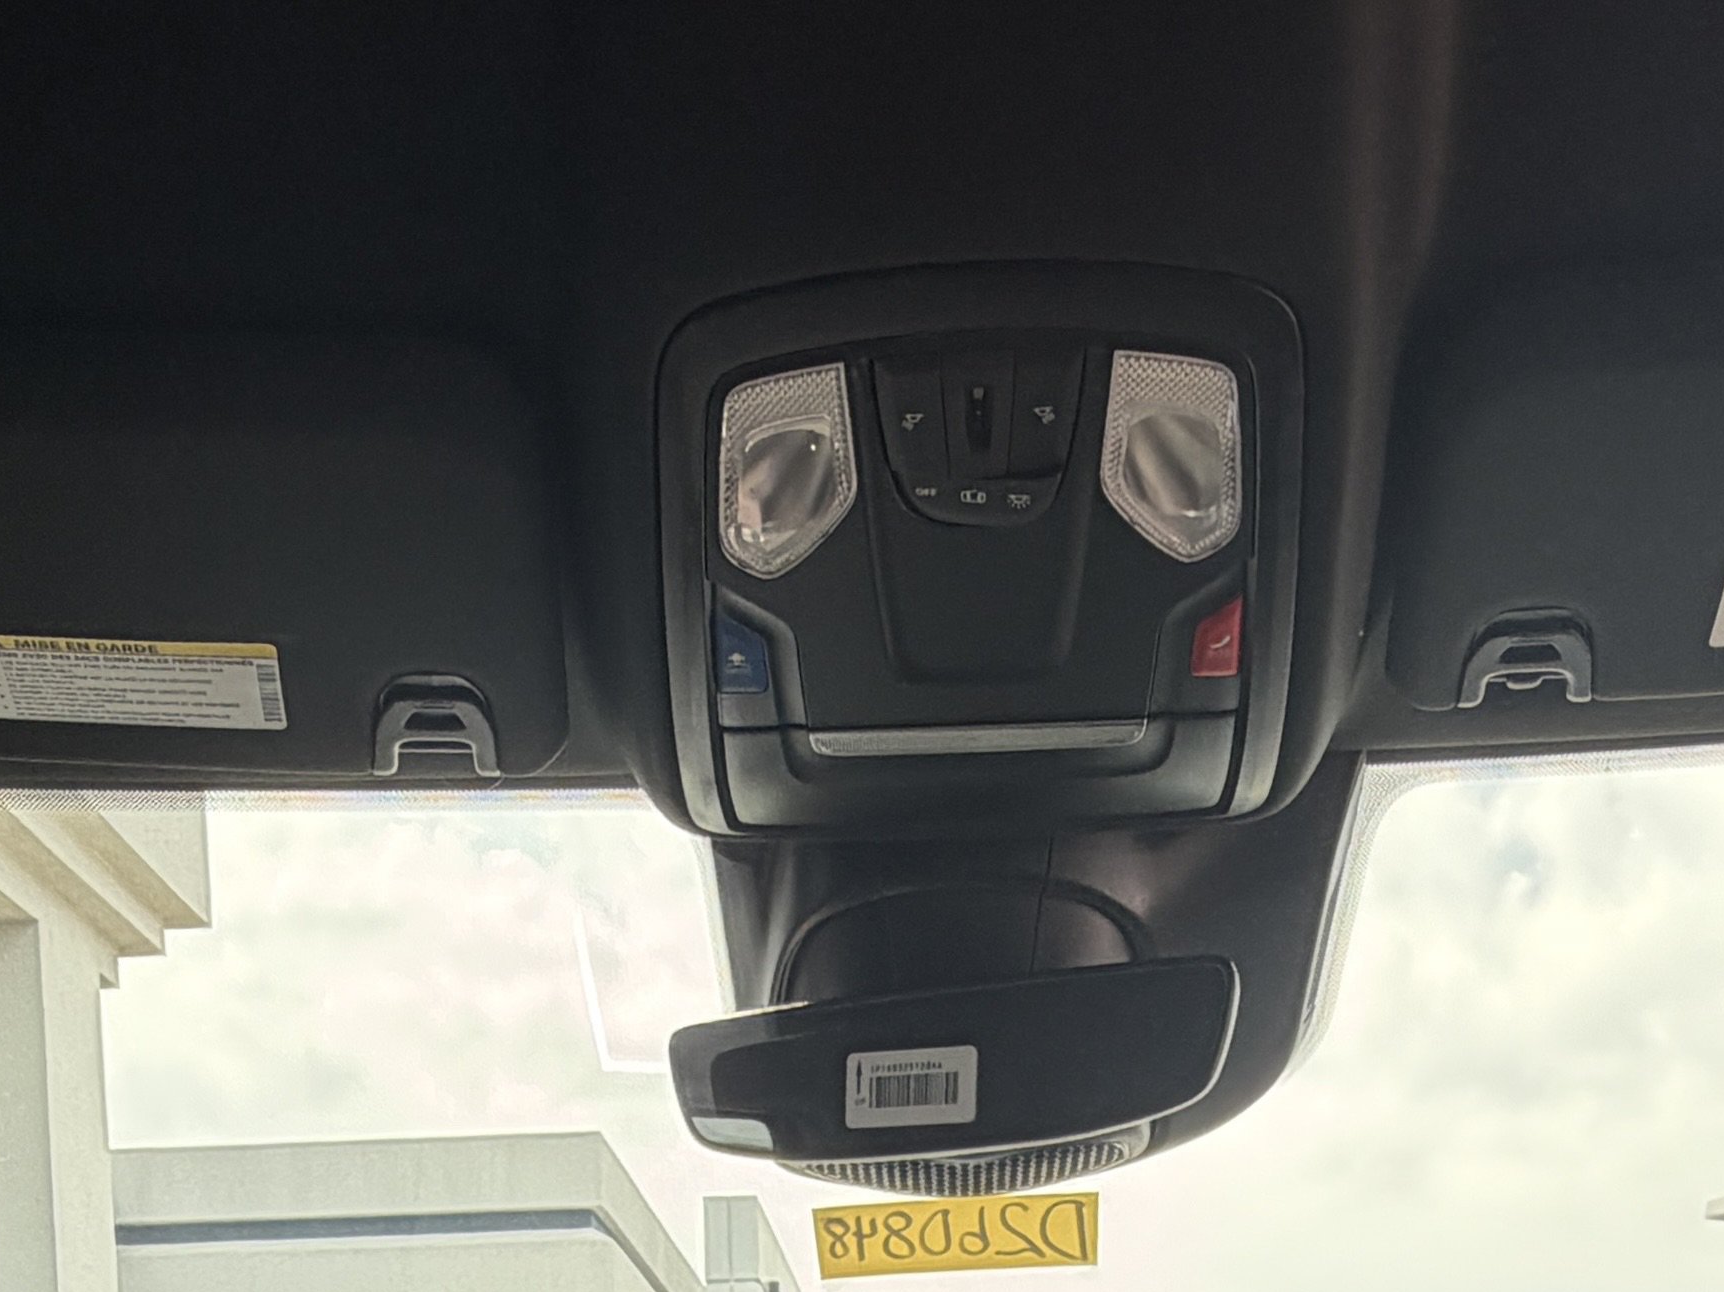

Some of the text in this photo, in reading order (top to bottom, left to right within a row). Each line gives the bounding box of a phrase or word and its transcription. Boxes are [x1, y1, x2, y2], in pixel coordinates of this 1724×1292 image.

[13, 639, 160, 654] MISE EN GARDE
